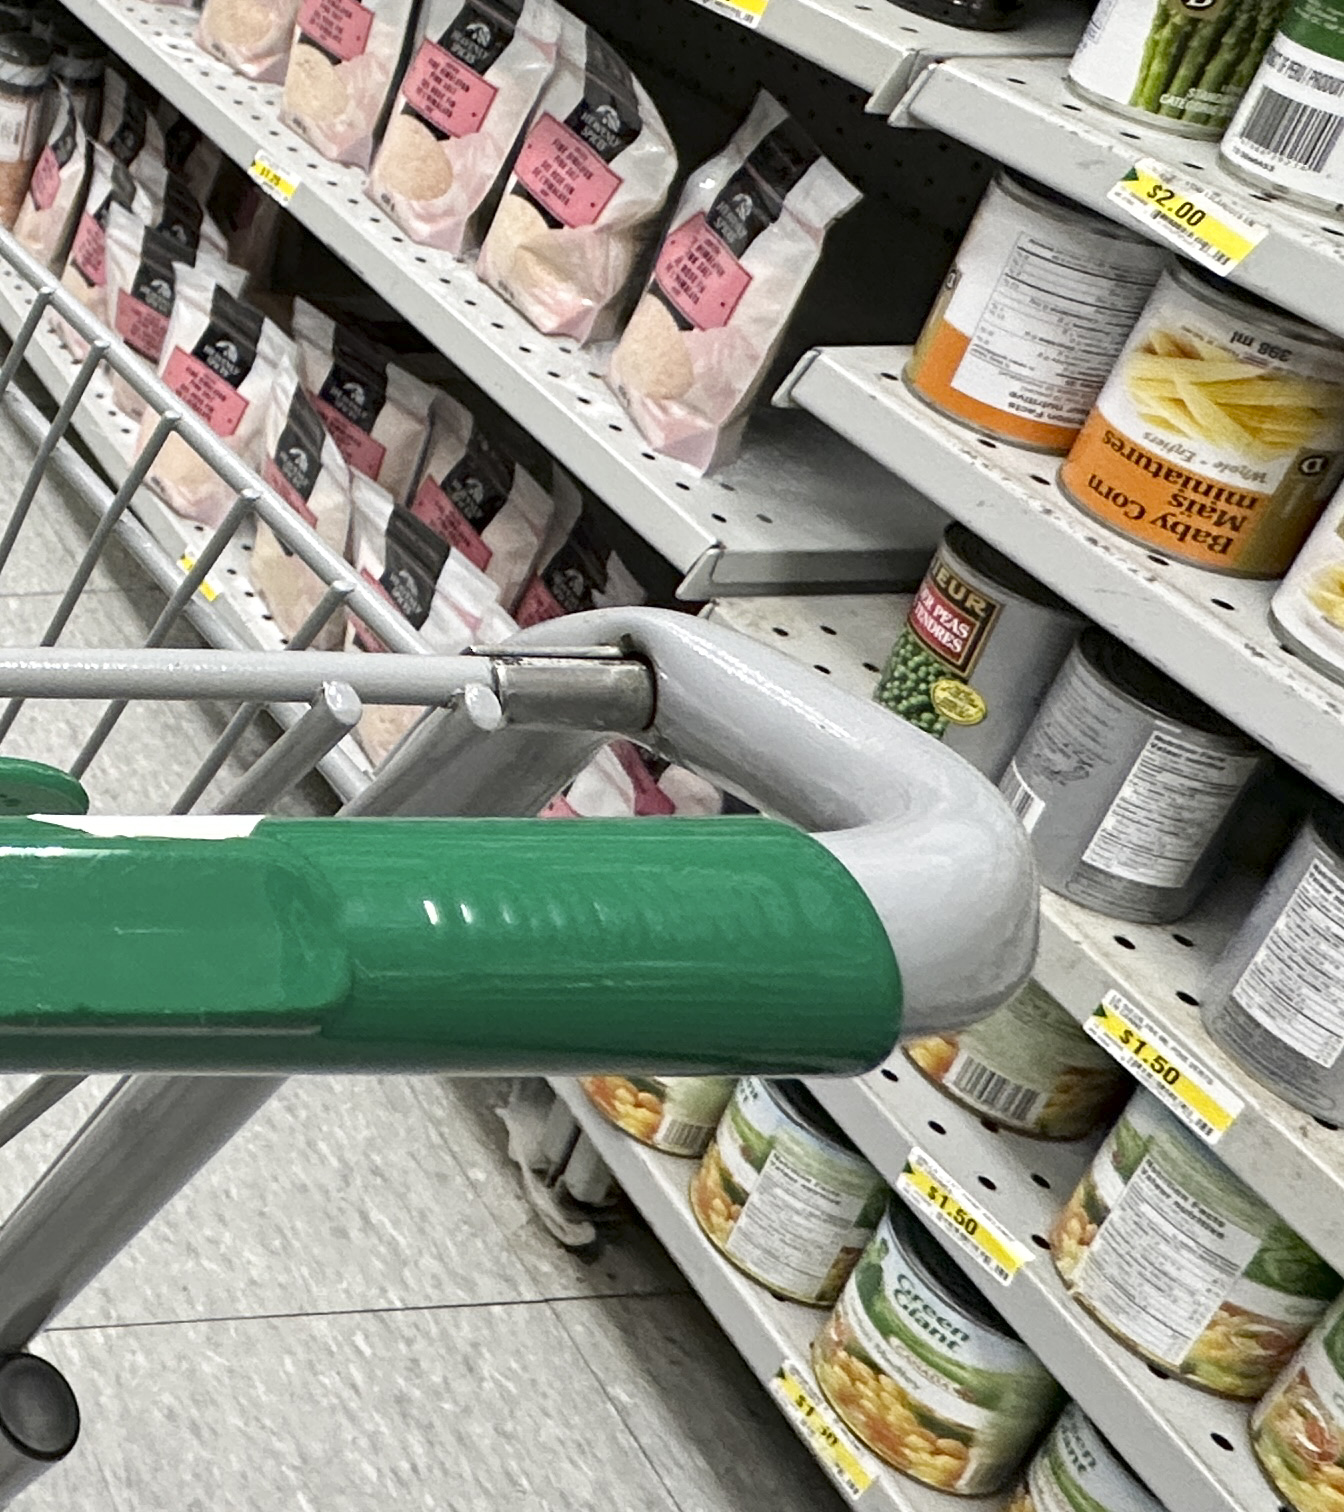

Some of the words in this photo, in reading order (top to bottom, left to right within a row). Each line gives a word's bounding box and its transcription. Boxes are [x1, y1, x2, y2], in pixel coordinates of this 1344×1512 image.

[1147, 184, 1206, 227] $2.00
[1230, 331, 1254, 347] ml
[1102, 429, 1259, 511] miniatures
[1301, 456, 1325, 475] D
[1088, 473, 1146, 522] Corn
[1168, 491, 1248, 533] Maïs
[1150, 511, 1234, 555] Baby
[933, 603, 971, 639] PEAS
[1119, 1027, 1180, 1087] $1.50
[927, 1185, 979, 1237] $1.50
[892, 1287, 961, 1354] Giant
[897, 1274, 969, 1342] Green
